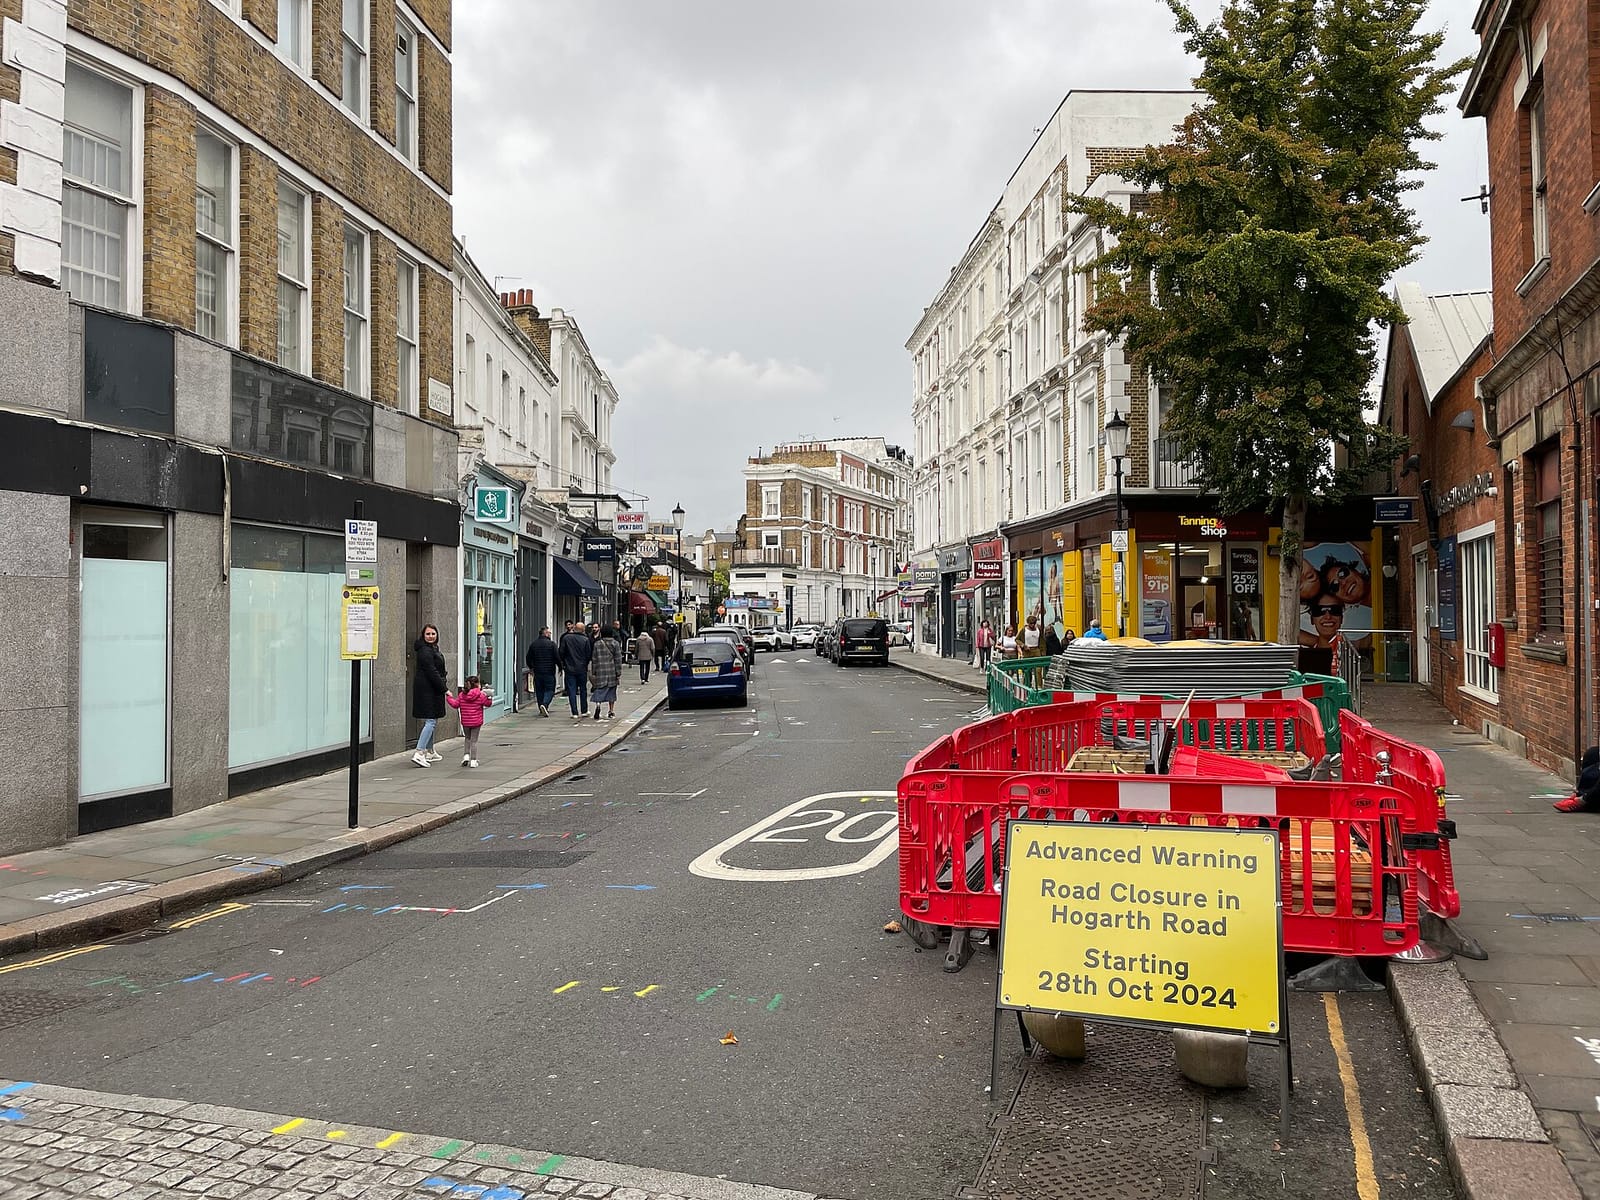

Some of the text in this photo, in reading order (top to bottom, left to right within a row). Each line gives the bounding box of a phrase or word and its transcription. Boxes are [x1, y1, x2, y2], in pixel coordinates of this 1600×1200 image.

[1178, 515, 1218, 528] Tanning
[1200, 525, 1228, 538] Shop
[1147, 580, 1169, 593] 91p
[1232, 574, 1258, 584] 25%
[1235, 584, 1256, 593] OFF
[749, 808, 899, 843] 20
[1025, 840, 1258, 874] Advanced Warning
[1040, 878, 1240, 910] Road Closure in
[1051, 904, 1228, 937] Hogarth Road
[1083, 947, 1189, 981] Starting
[1037, 970, 1237, 1010] 28th Oct 2024
